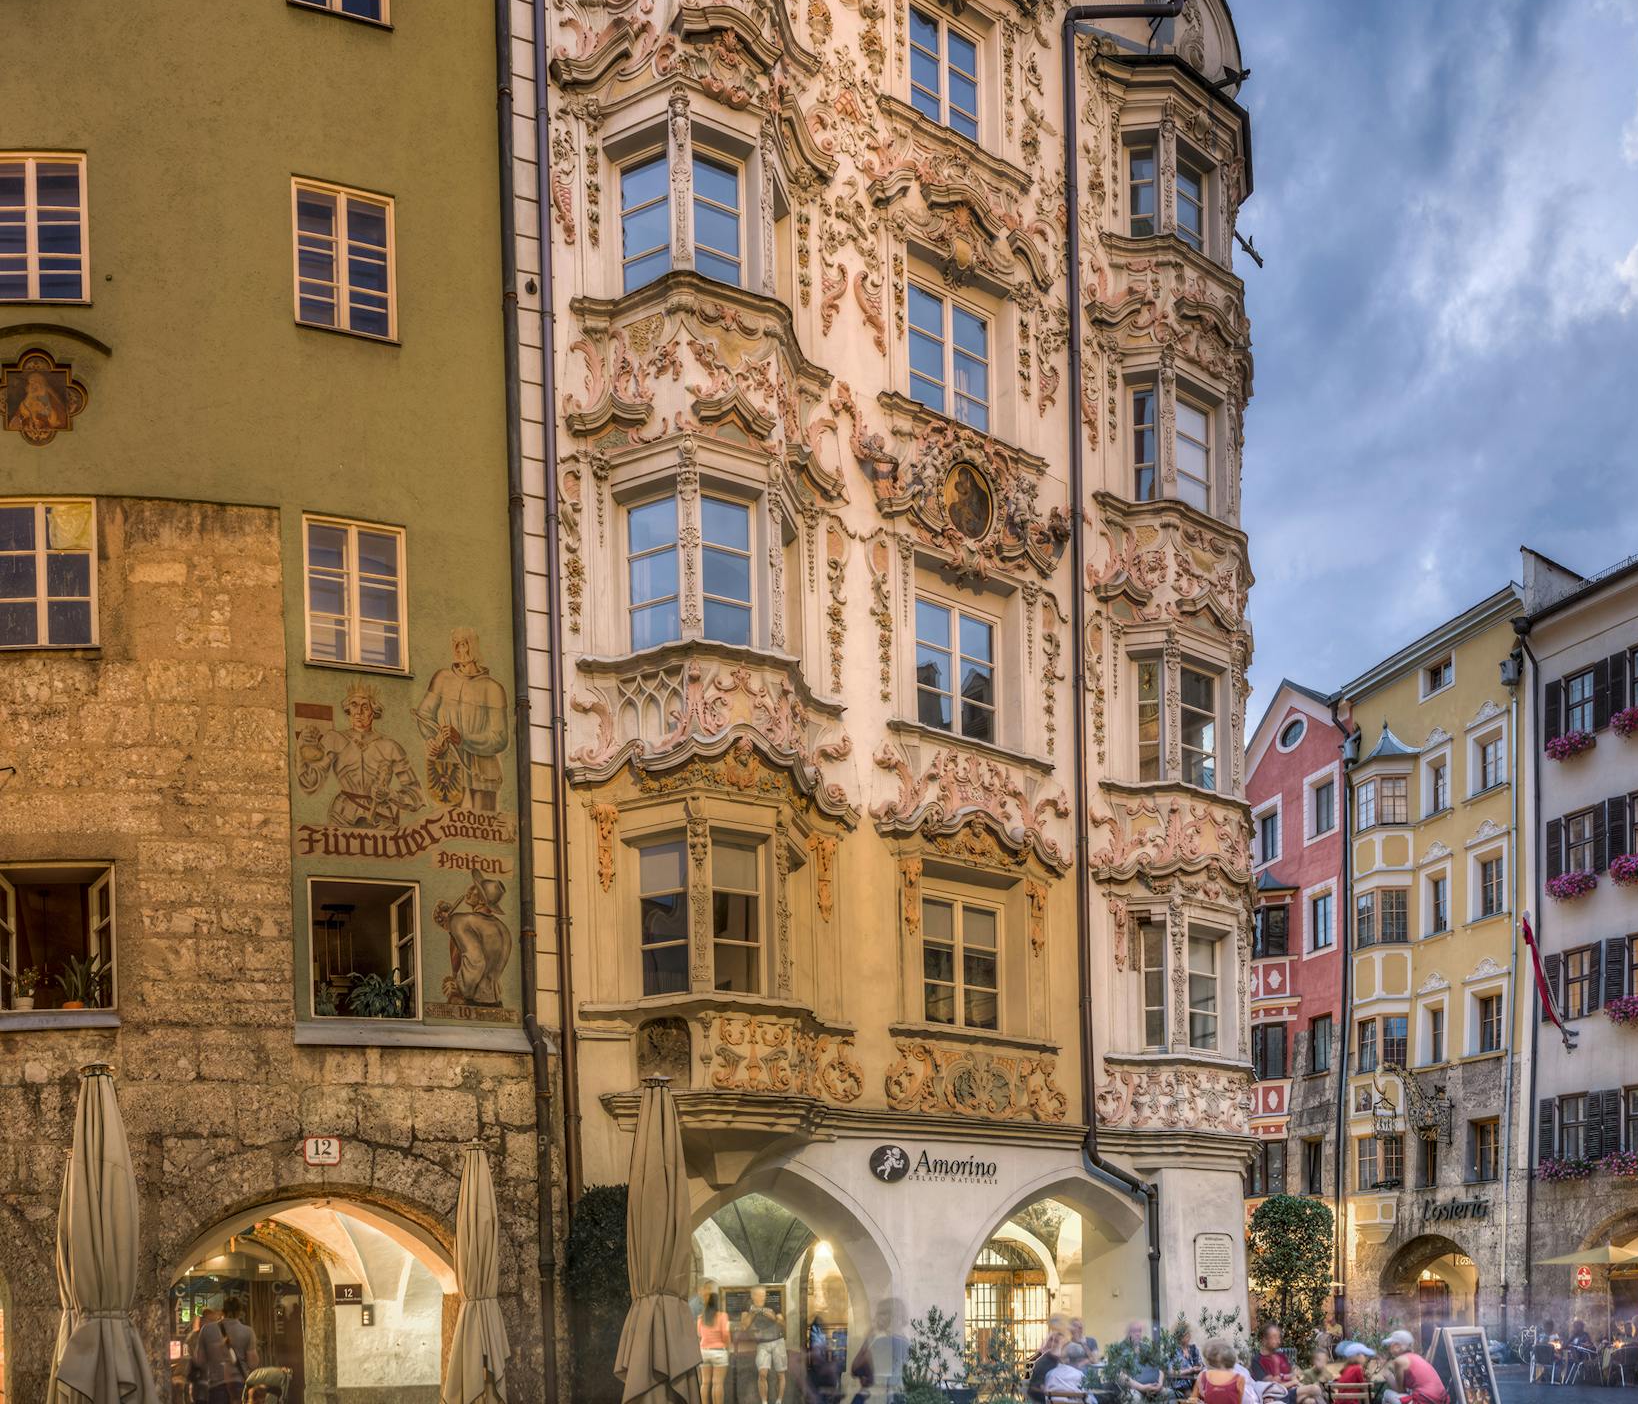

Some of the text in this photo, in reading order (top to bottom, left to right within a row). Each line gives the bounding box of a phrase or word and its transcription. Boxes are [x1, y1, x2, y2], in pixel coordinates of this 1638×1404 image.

[438, 850, 512, 875] Pfeifen
[313, 1139, 332, 1156] 12
[913, 1149, 998, 1178] Amorino
[908, 1174, 999, 1186] GELATO NATURALE
[343, 1287, 354, 1299] 12
